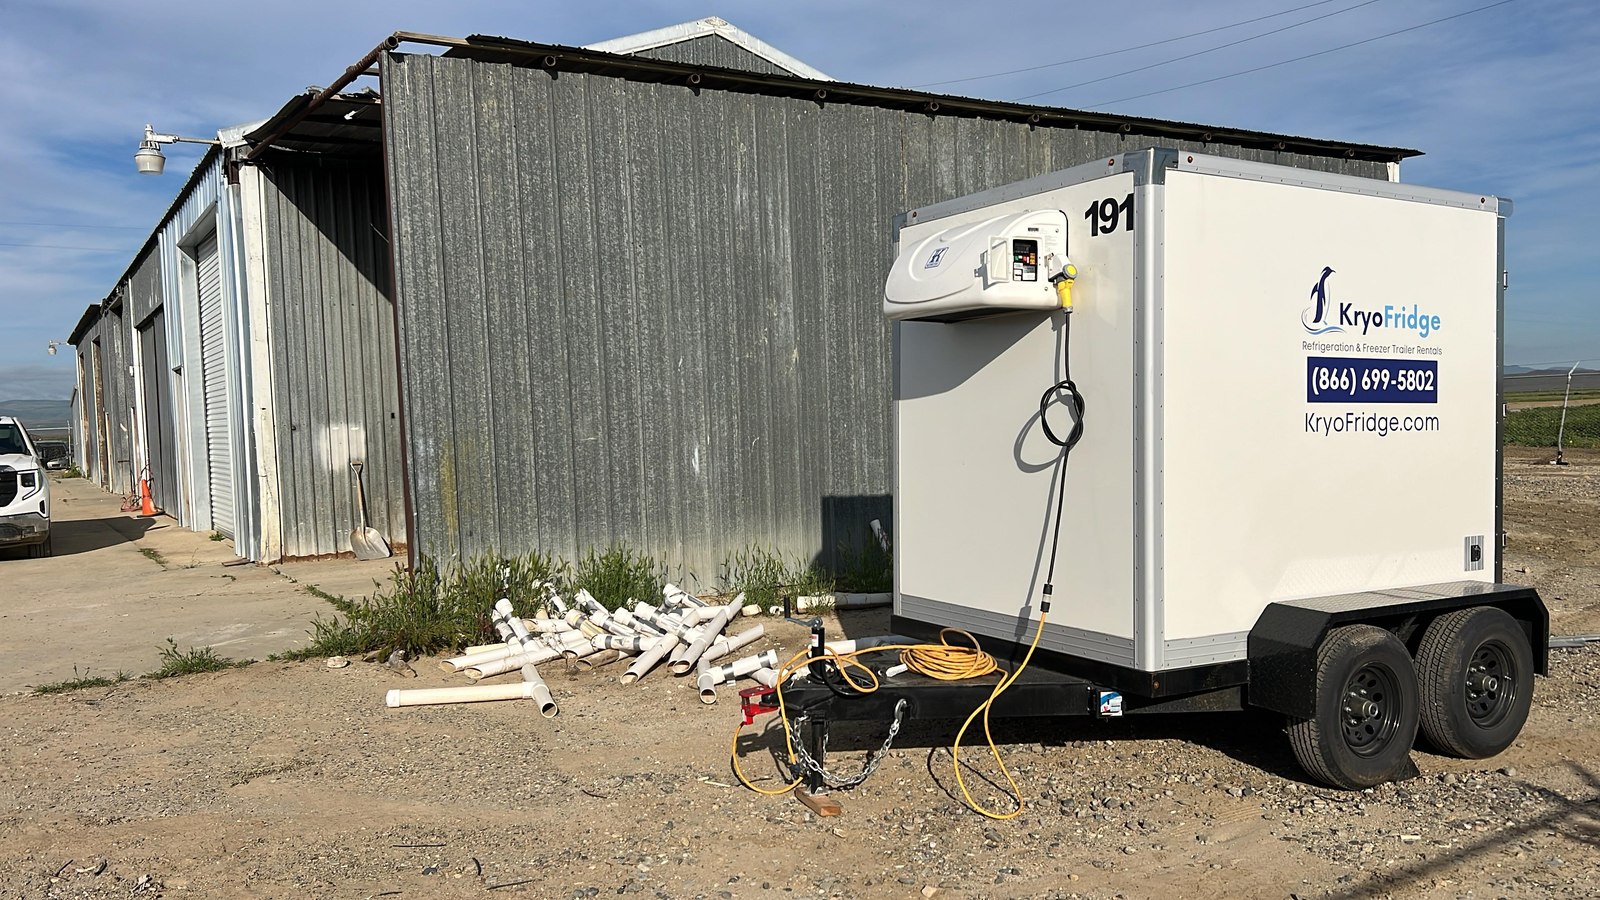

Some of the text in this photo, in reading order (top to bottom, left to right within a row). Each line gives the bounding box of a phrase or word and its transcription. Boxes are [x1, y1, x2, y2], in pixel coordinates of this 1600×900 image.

[1085, 193, 1134, 237] 191
[1340, 302, 1441, 338] KryoFridge
[1302, 340, 1443, 355] Refrigeration & Freezer Trailer Rentals
[1312, 366, 1434, 395] (866) 699-5802
[1305, 411, 1440, 437] KryoFridge.com
